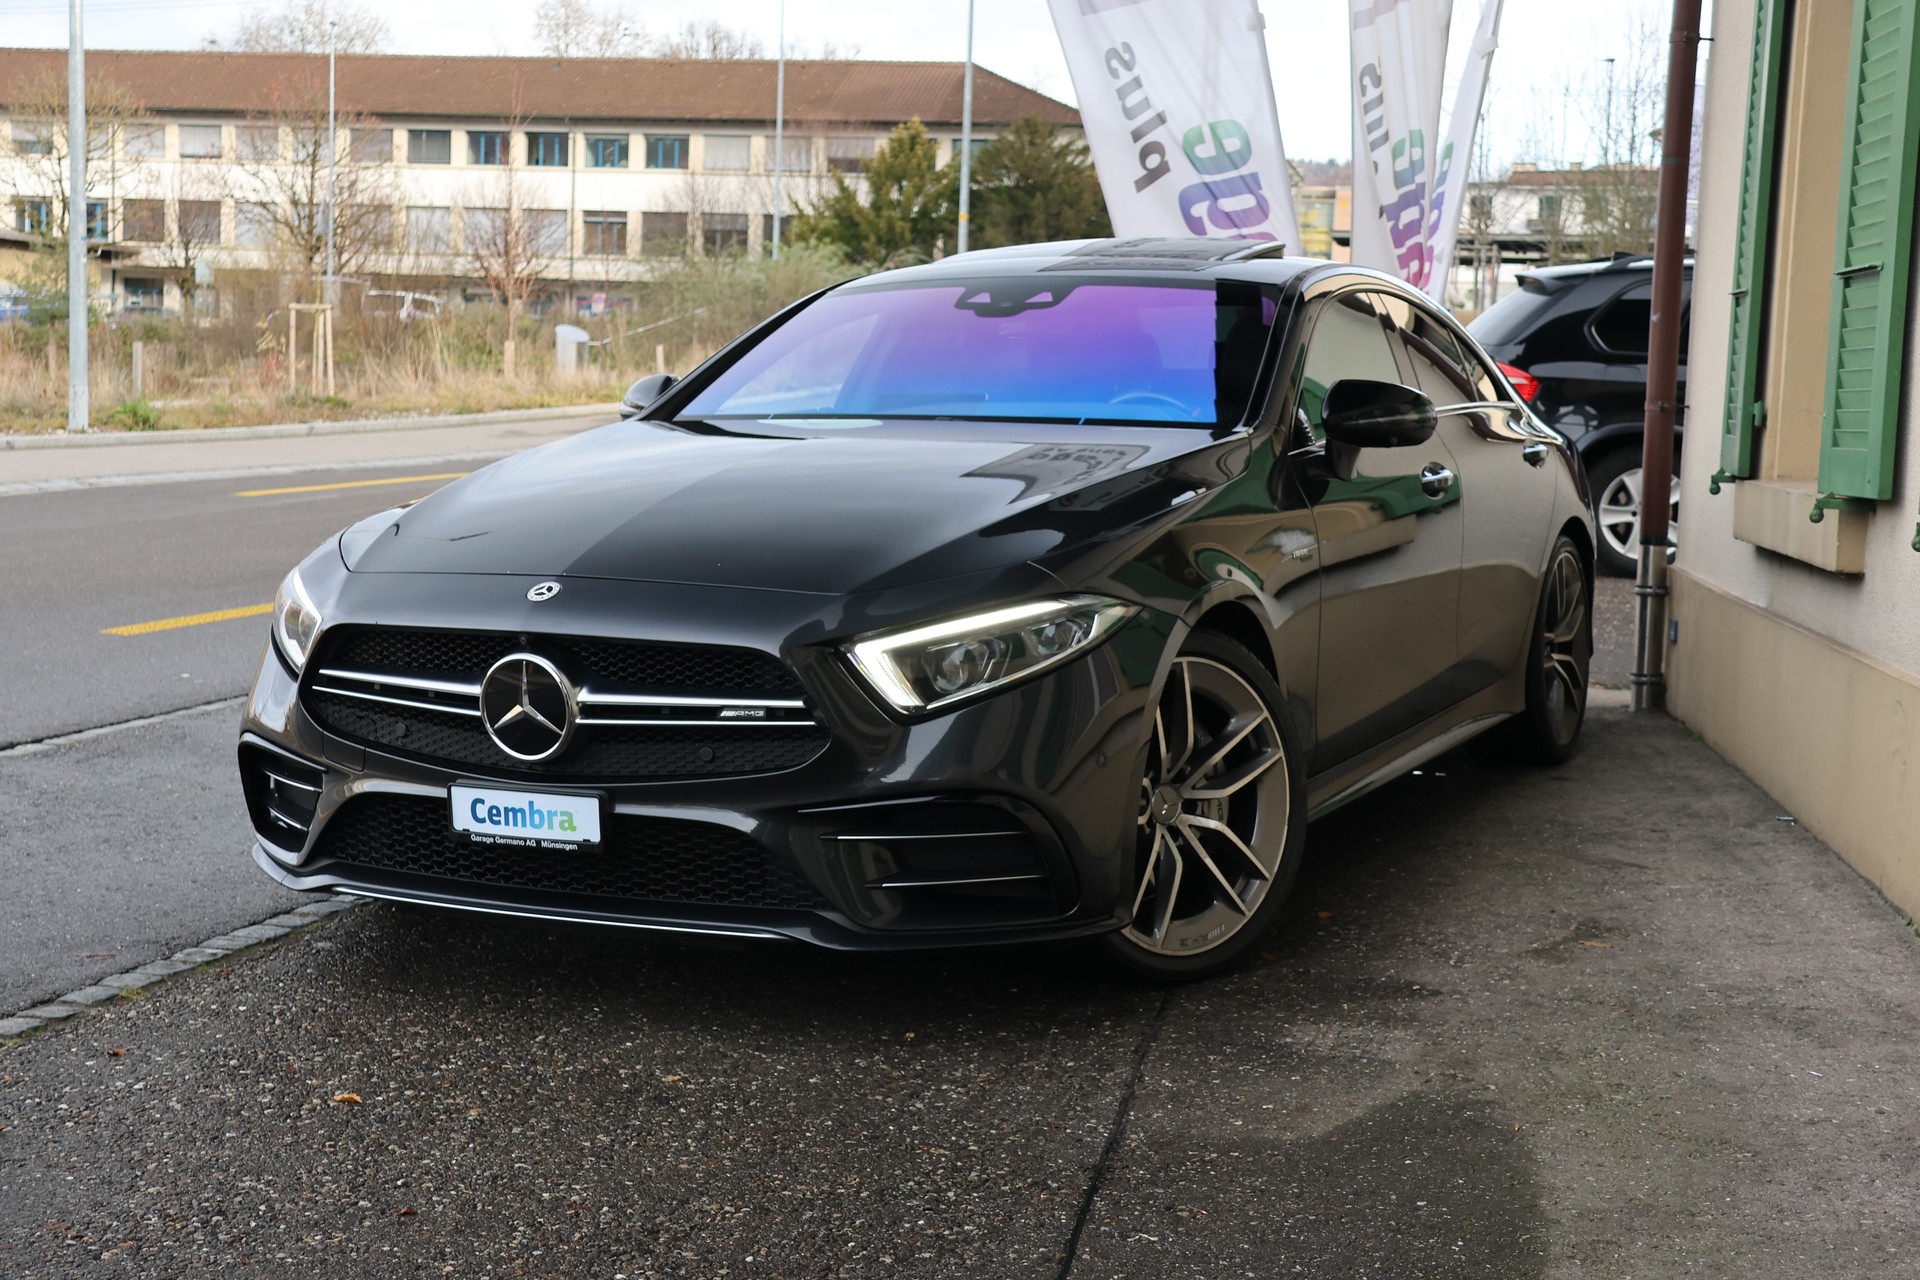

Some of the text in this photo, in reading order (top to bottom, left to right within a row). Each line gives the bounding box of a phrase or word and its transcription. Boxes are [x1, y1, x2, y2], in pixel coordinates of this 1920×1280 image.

[470, 797, 577, 832] Cembra
[470, 834, 578, 851] Garage Germano AG Münsingen
